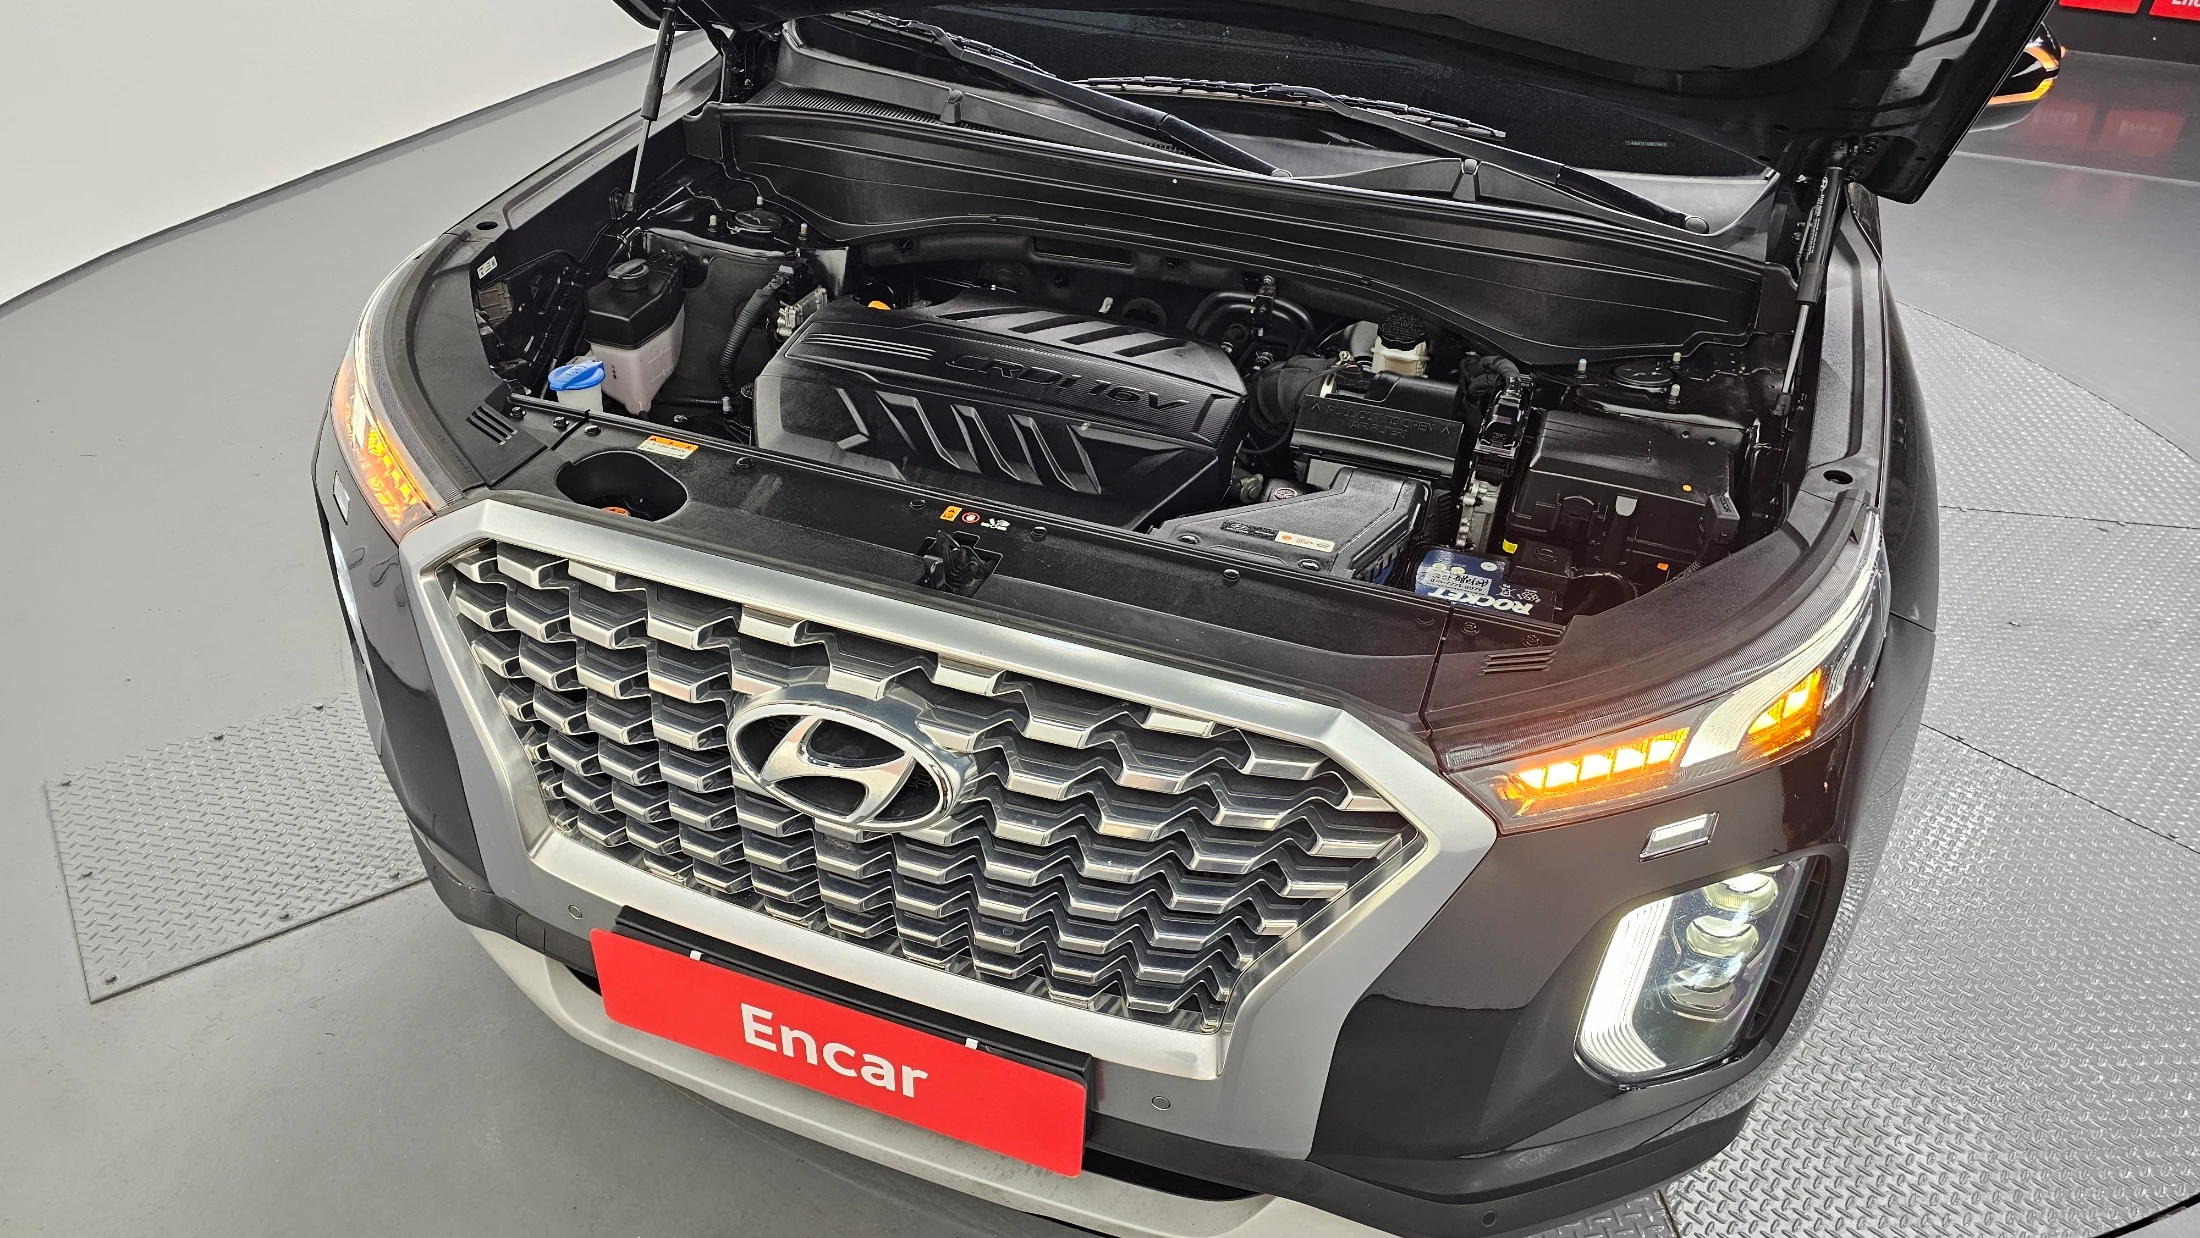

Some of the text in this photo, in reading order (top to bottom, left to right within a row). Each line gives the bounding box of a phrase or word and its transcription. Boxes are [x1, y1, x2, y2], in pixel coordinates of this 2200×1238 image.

[1088, 378, 1190, 411] 16V
[1326, 403, 1437, 432] PULL OUT TO OPEN
[1427, 587, 1534, 616] ROCKET
[740, 1002, 930, 1099] Encar
